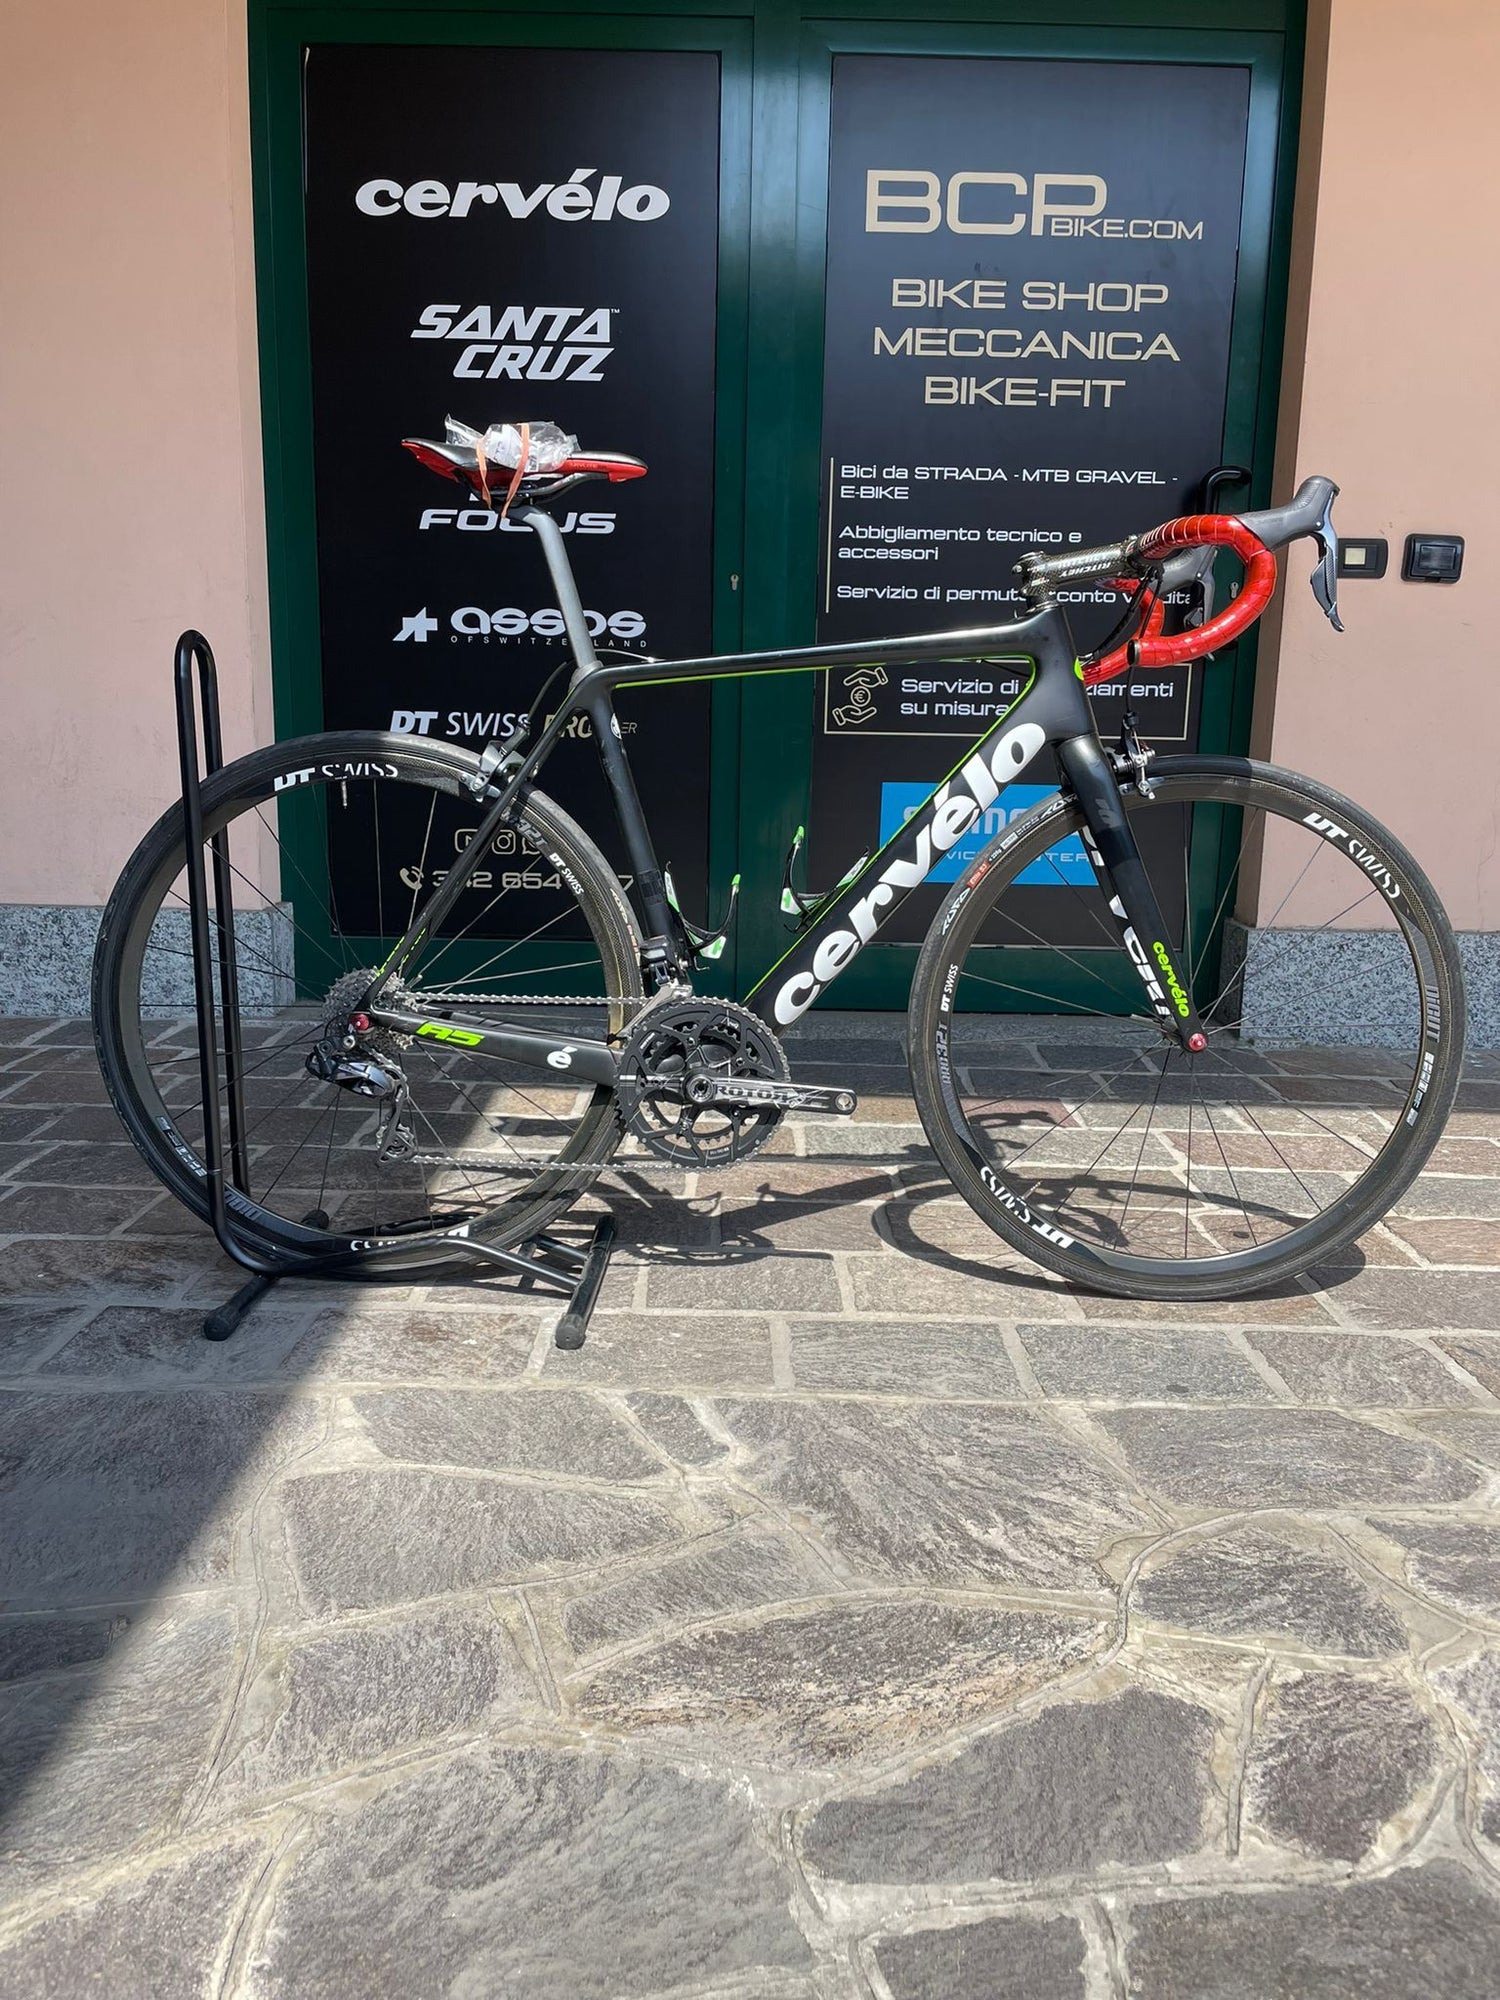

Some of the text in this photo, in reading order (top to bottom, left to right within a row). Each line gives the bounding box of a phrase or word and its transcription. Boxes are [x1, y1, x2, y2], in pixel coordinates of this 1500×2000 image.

[355, 168, 670, 221] cervélo
[865, 169, 1204, 240] BCP BIKE.COM
[892, 277, 1169, 312] BIKE SHOP
[410, 304, 611, 343] SANTA
[873, 326, 1181, 361] MECCANICA
[453, 344, 615, 381] CRUZ
[924, 375, 1126, 408] BIKE-FIT
[840, 464, 877, 480] Bici
[882, 465, 908, 480] da
[914, 466, 1008, 482] STRADA
[1075, 469, 1166, 484] GRAVEL
[840, 485, 910, 500] E-BIKE
[838, 525, 1082, 543] Abbigliamento tecnico e
[837, 546, 939, 561] accessori
[836, 585, 918, 600] Servizio
[923, 586, 941, 600] di
[1049, 590, 1116, 604] conto
[450, 606, 647, 638] assos
[901, 678, 994, 694] Servizio
[1000, 679, 1019, 695] di
[390, 710, 438, 734] DT
[900, 700, 1010, 717] su misura
[431, 870, 563, 890] 32 654
[549, 852, 585, 895] DT SWISS
[773, 722, 1046, 1025] cervélo
[944, 963, 959, 995] SWISS
[1152, 941, 1190, 1018] cervélo
